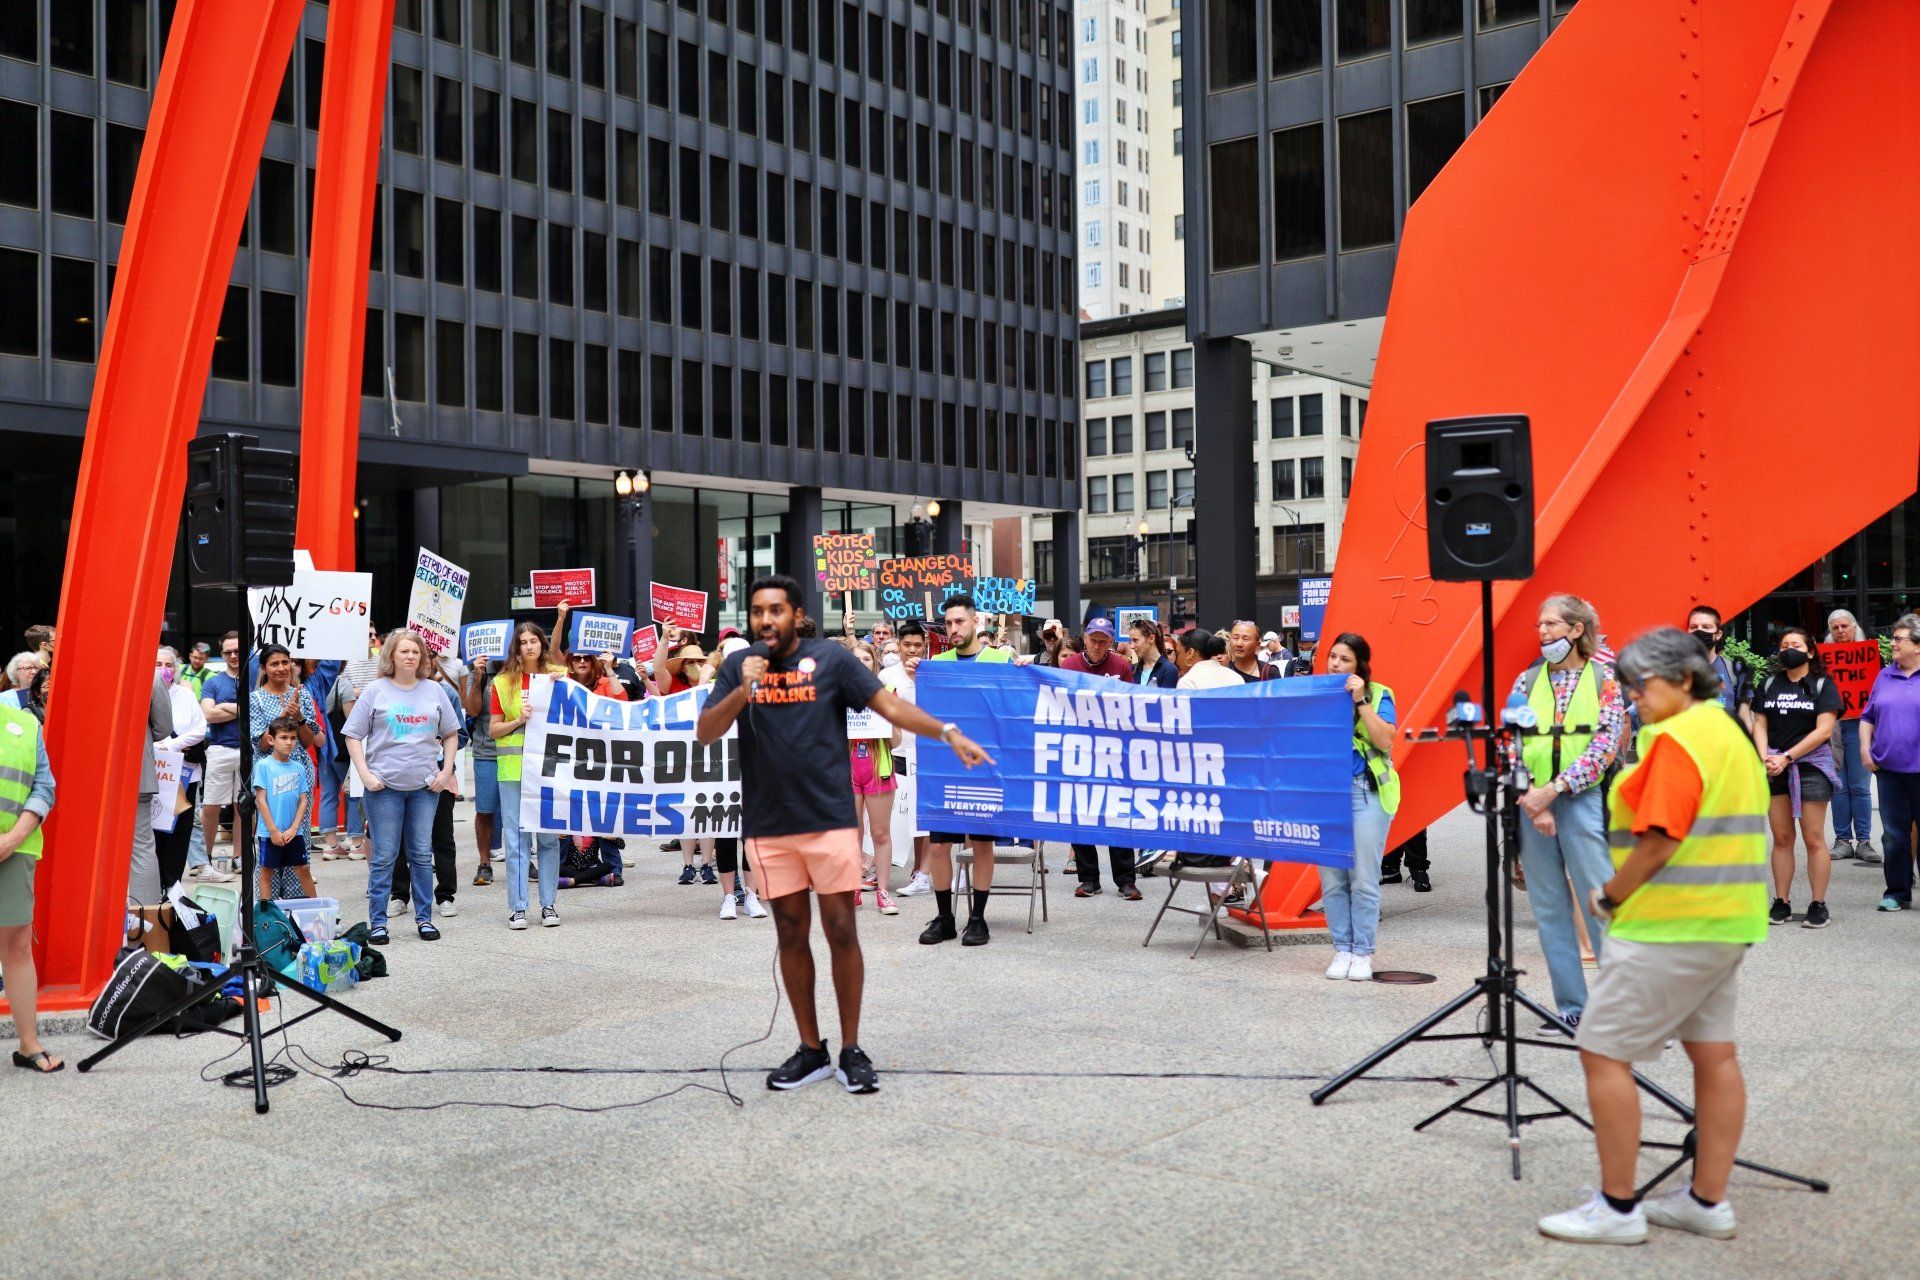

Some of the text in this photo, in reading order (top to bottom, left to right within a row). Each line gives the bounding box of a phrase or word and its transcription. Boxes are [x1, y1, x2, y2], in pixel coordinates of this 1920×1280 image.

[813, 535, 873, 550] PROTECT
[827, 550, 864, 563] KIDS
[420, 554, 431, 567] GET
[442, 565, 452, 579] OF
[829, 564, 860, 577] NOT
[883, 556, 945, 572] CHANGE
[416, 567, 428, 582] GET
[440, 579, 449, 592] OF
[824, 573, 876, 591] GUNS!
[880, 569, 953, 589] GUN LAWS
[1302, 580, 1332, 589] MARCH
[882, 589, 905, 603] OR
[1303, 589, 1330, 597] FOR OU
[676, 600, 703, 609] PROTECT
[1302, 597, 1326, 606] LIVES
[885, 602, 924, 619] VOTE
[585, 620, 618, 632] MARCH
[468, 628, 497, 638] MARCH
[584, 629, 622, 641] FOR OUR
[468, 636, 501, 648] FOR OUR
[583, 638, 609, 650] LIVES
[637, 636, 655, 645] PROTECT
[638, 641, 652, 649] PUBLIC
[468, 646, 487, 657] LIVES
[639, 645, 655, 653] HEALTH
[1822, 646, 1877, 666] EFUND
[1832, 668, 1865, 682] THE
[765, 686, 816, 703] VIOLENCE
[1777, 693, 1798, 701] STOP
[546, 680, 709, 731] MARC
[1034, 684, 1193, 735] MARCH
[1463, 702, 1476, 721] 9
[1777, 701, 1814, 710] VIOLENCE
[395, 713, 428, 724] Votes
[541, 733, 644, 784] FOR
[1034, 732, 1226, 786] FOR OUR
[540, 786, 685, 835] LIVES
[944, 801, 1003, 813] EVERYTOWN
[1033, 781, 1160, 831] LIVES
[1253, 819, 1320, 840] GIFFORDS
